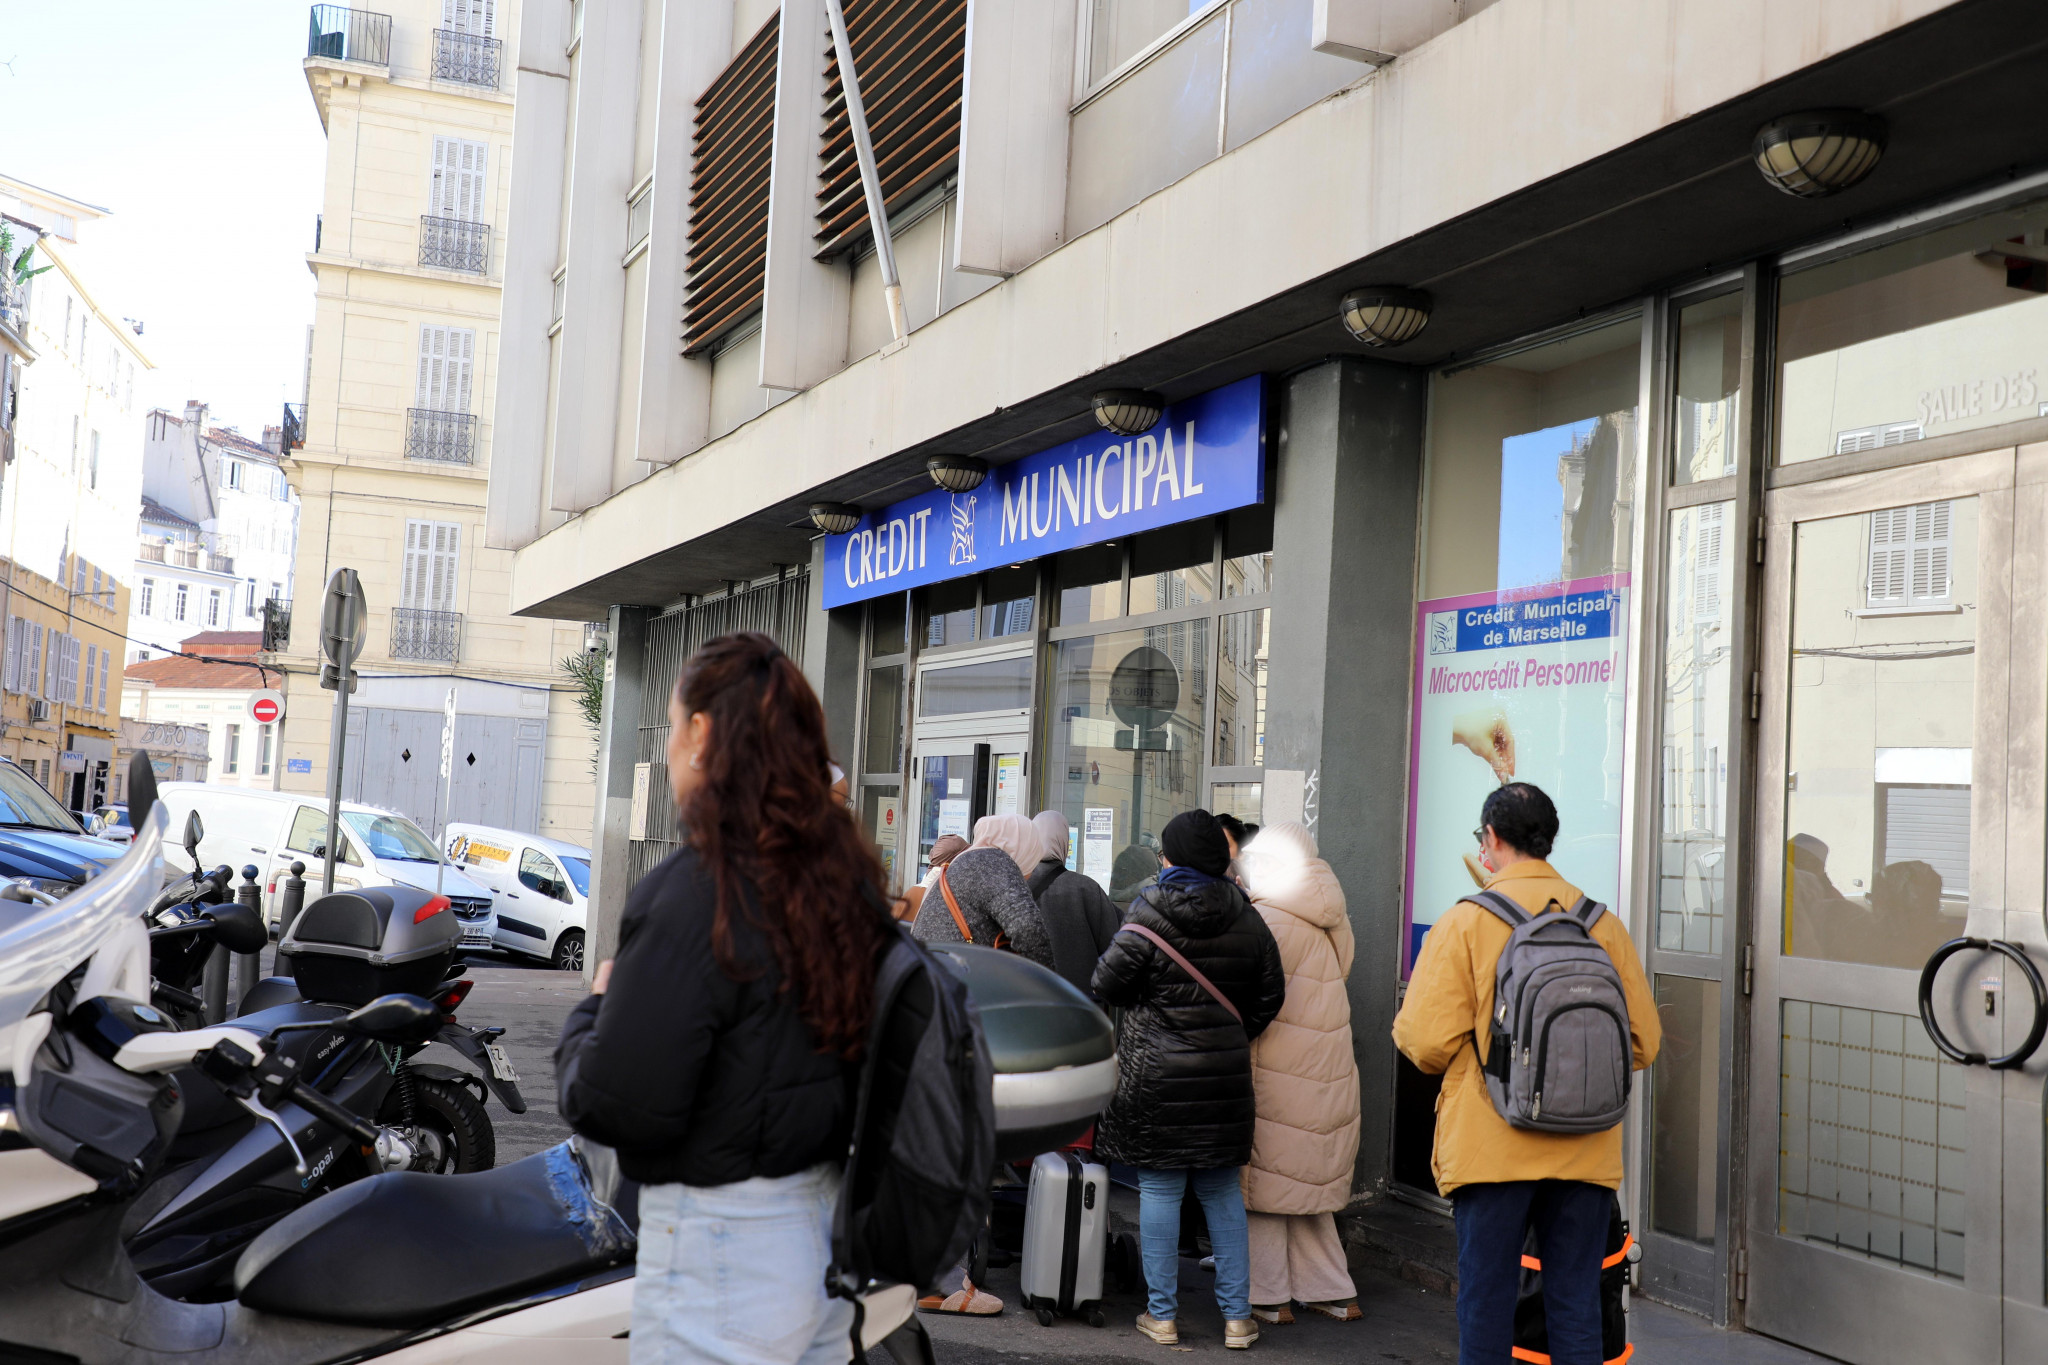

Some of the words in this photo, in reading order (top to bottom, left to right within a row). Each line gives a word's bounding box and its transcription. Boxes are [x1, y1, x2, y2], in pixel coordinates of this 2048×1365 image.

[1916, 380, 1983, 426] SALLE
[1991, 368, 2038, 412] DES
[844, 507, 932, 588] CREDIT
[1000, 420, 1203, 547] MUNICIPAL
[1465, 606, 1515, 627] Crédit
[1524, 593, 1612, 620] Municipal
[1483, 629, 1503, 646] de
[1508, 621, 1587, 644] Marseille
[1428, 660, 1520, 695] Microcrédit
[1523, 651, 1618, 689] Personnel
[301, 1146, 334, 1189] e-opai
